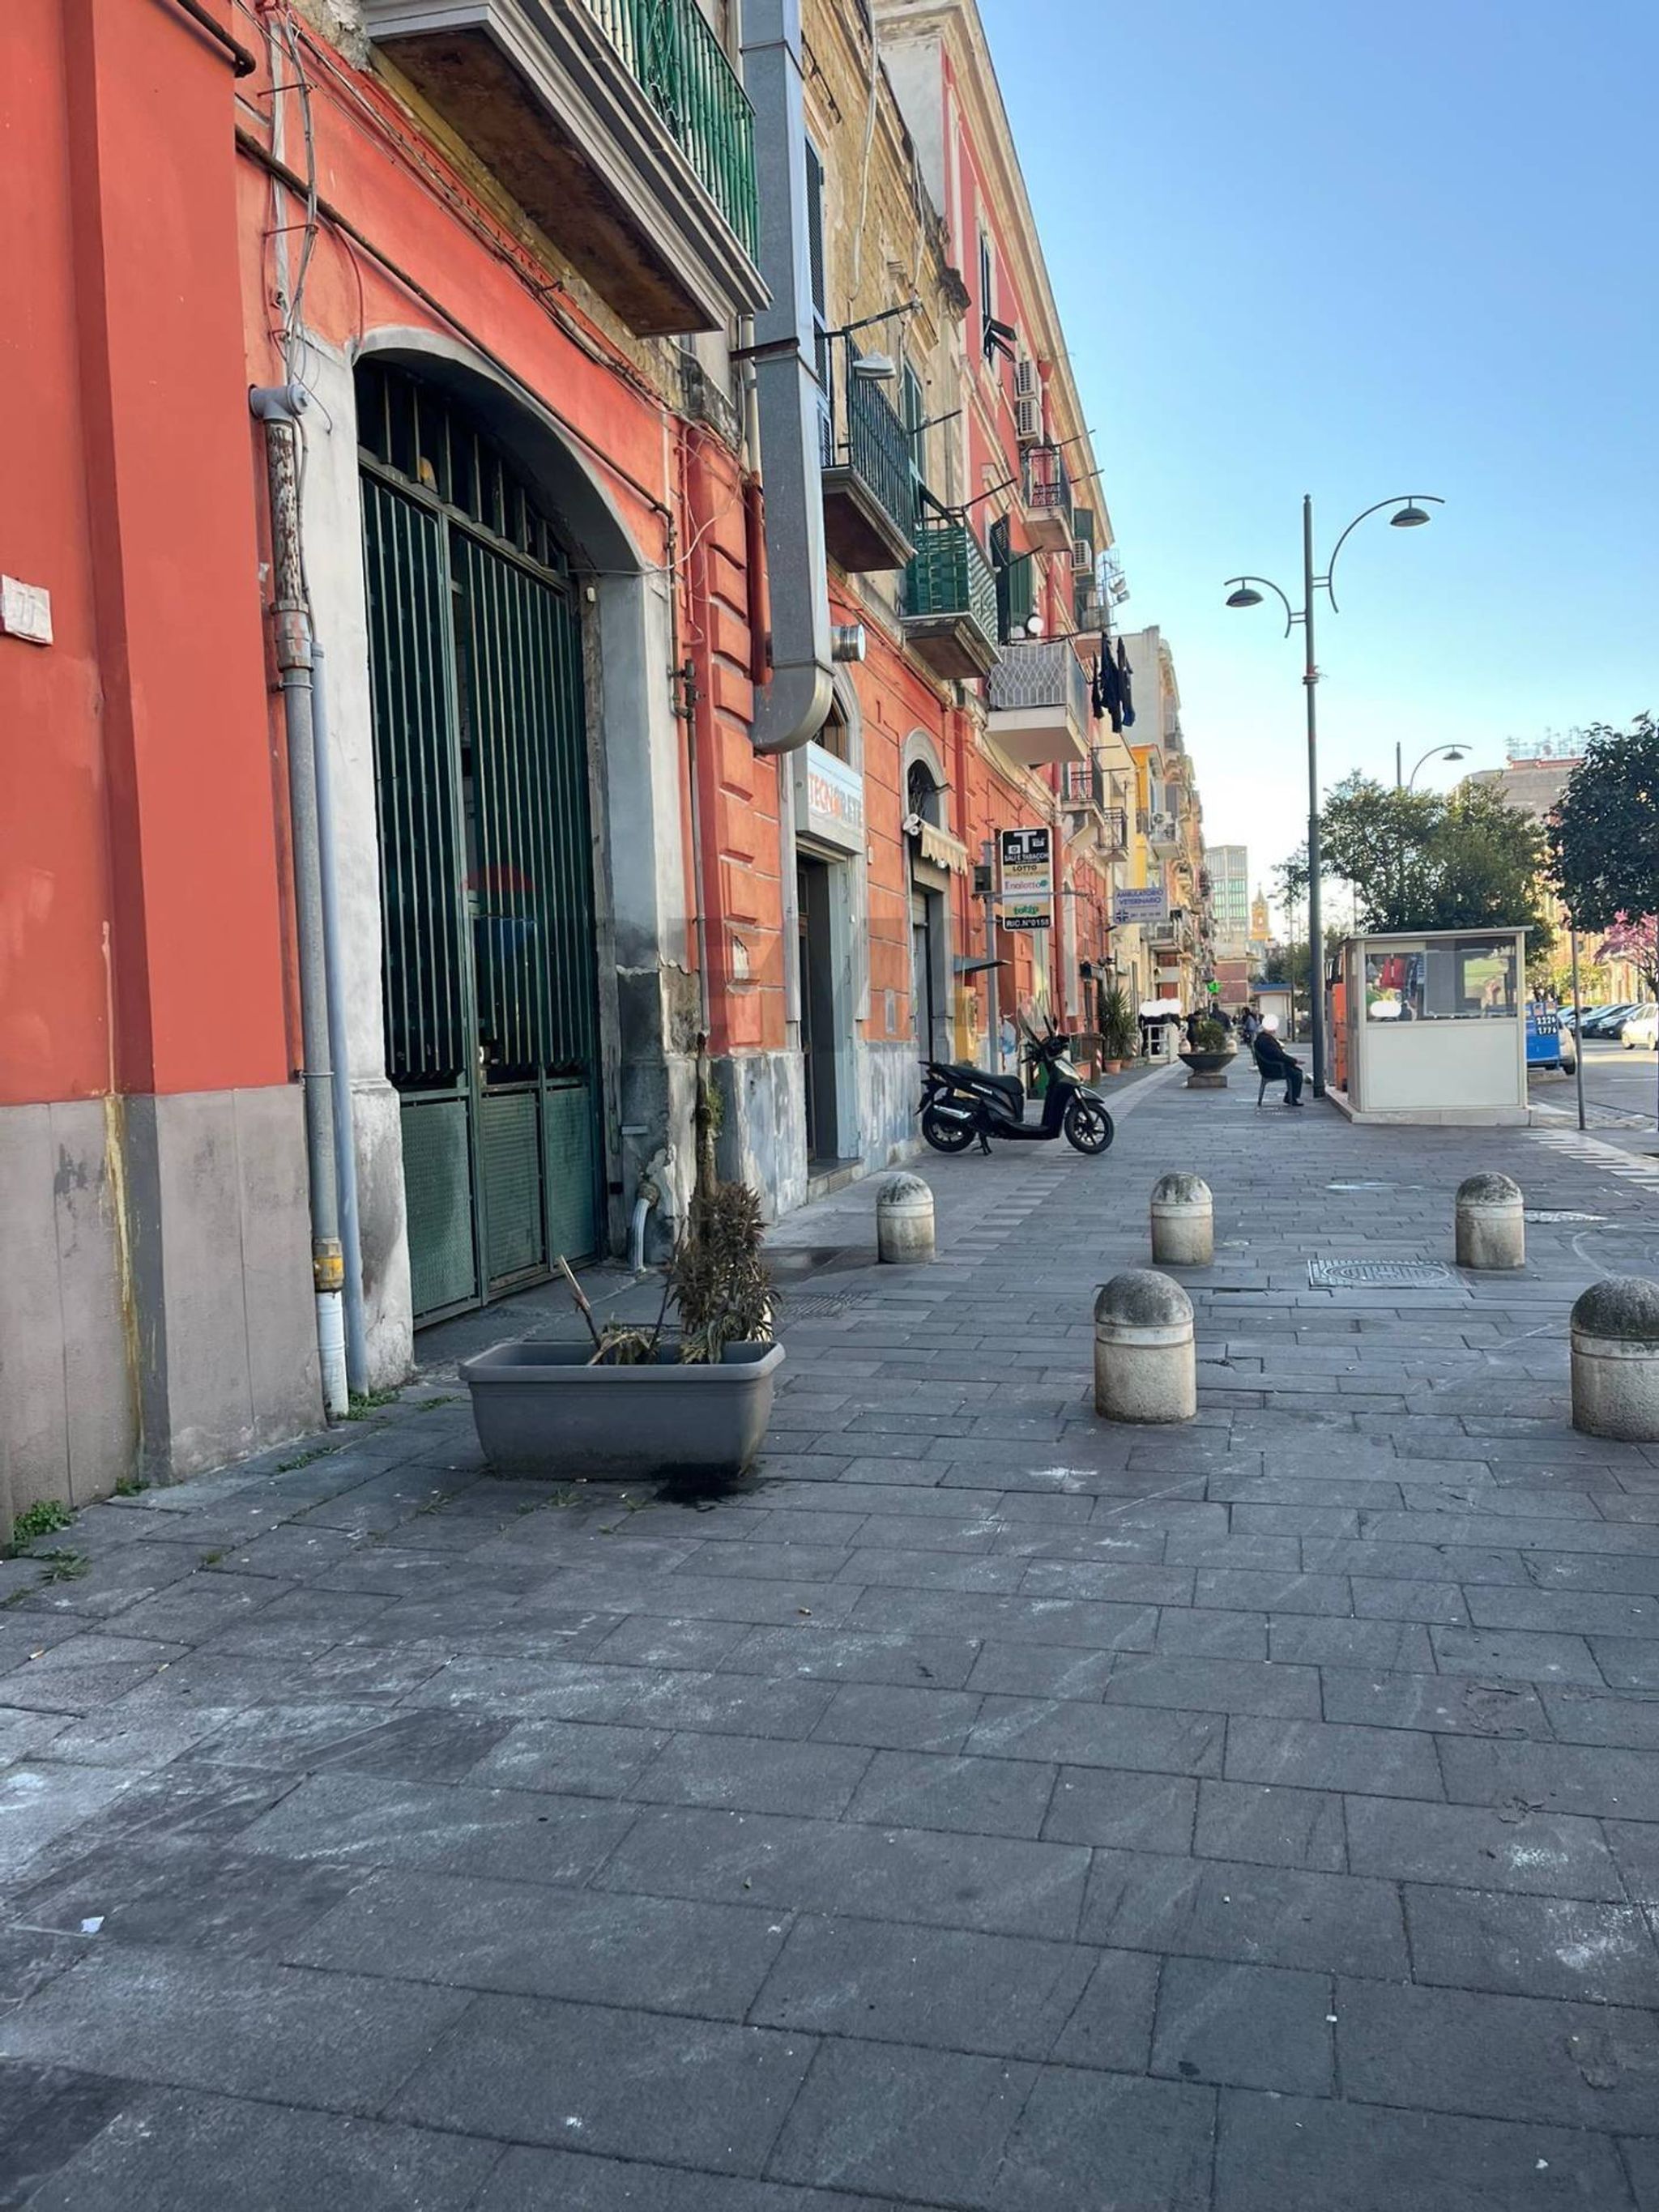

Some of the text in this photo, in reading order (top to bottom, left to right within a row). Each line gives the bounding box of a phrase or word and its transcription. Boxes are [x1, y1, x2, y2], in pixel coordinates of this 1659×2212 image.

[1013, 864, 1037, 872] LOTTO
[1004, 880, 1041, 889] Enalotto
[1117, 889, 1163, 898] AMBULATORIO
